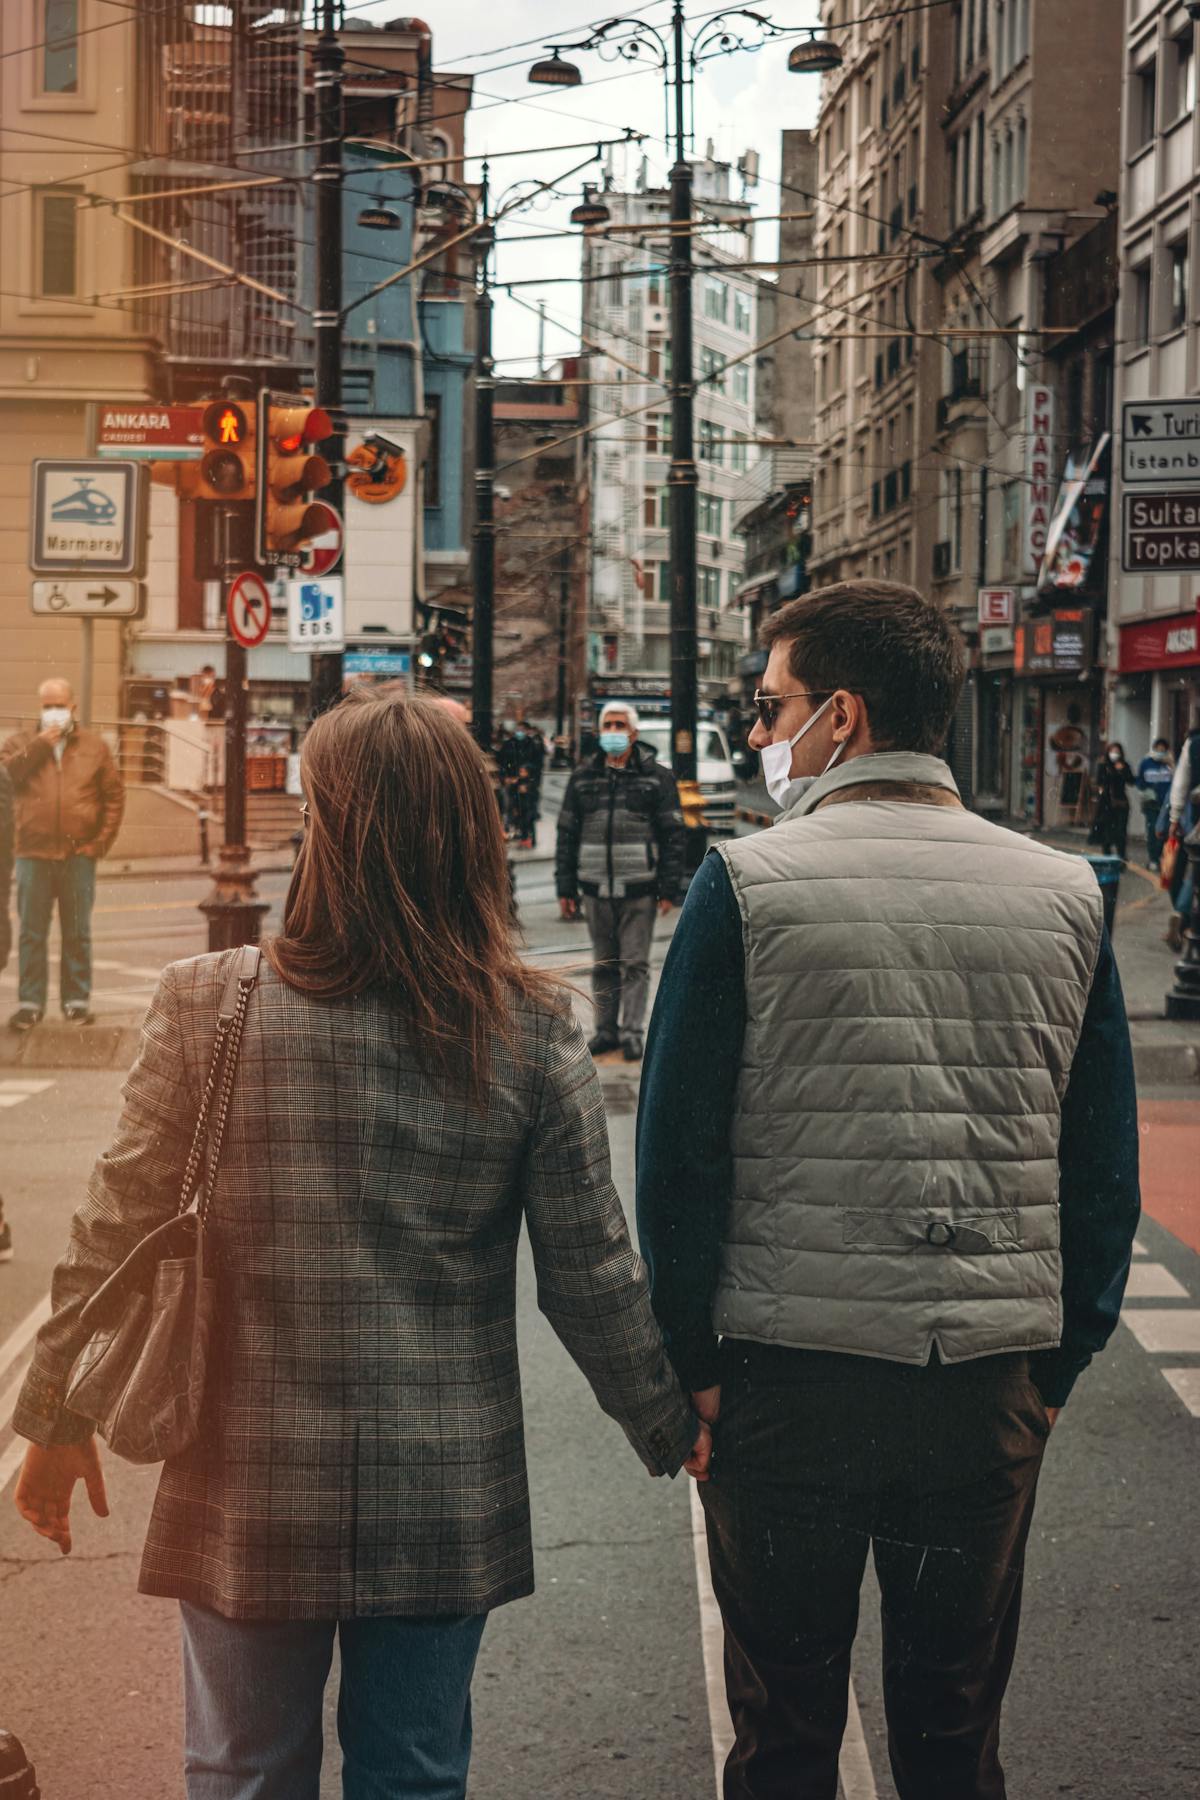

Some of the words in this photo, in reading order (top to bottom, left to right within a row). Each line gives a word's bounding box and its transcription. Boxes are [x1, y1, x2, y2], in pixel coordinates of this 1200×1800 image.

[104, 413, 170, 429] ANKARA
[1031, 391, 1048, 569] PHARMACY
[1134, 502, 1200, 526] Sulta
[48, 536, 122, 555] Marmaray
[1133, 537, 1200, 565] Topka
[989, 592, 1006, 617] E
[299, 622, 333, 635] EDS
